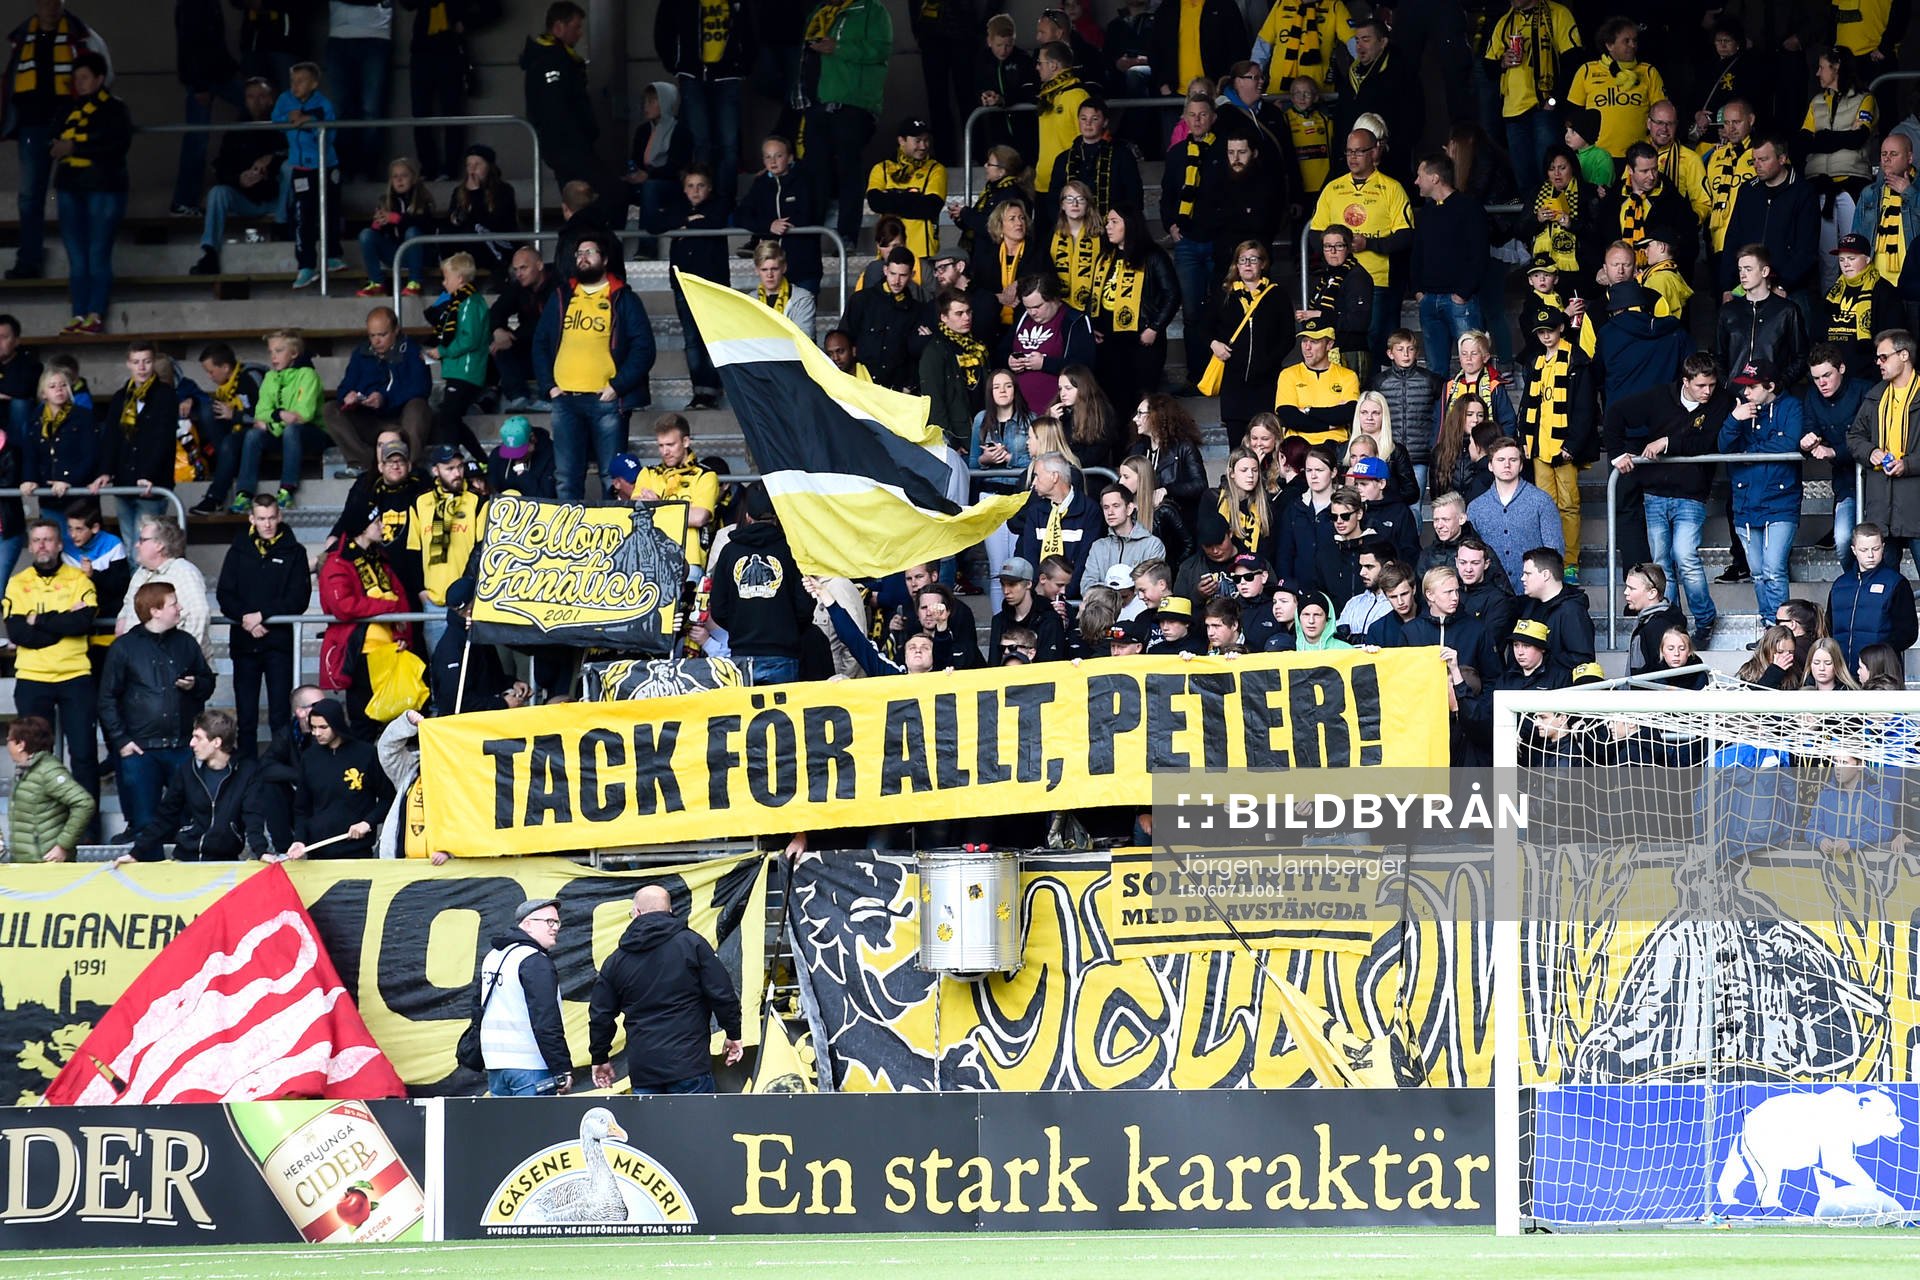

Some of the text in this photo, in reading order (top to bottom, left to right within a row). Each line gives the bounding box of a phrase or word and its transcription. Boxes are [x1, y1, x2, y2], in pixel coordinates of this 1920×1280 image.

[1594, 87, 1642, 107] ellos
[1712, 172, 1758, 191] eos
[562, 310, 606, 332] ellos
[488, 496, 624, 559] Yellow
[477, 542, 660, 610] Fanatics
[543, 609, 581, 622] 2001
[483, 663, 1383, 830] TACK FÖR ALLT, PETER!
[0, 911, 198, 950] ULIGANER
[1122, 897, 1368, 926] MED DE AVSTÄNGDA
[74, 959, 106, 976] 1991
[283, 1124, 355, 1181] HERRLJUNGA
[731, 1122, 1491, 1215] En stark karaktär
[295, 1140, 373, 1208] CIDER
[499, 1151, 681, 1217] GÄSENE MEJERI
[487, 1226, 528, 1235] SVERIGES
[530, 1226, 562, 1235] MINSTA
[565, 1224, 640, 1235] MEJERIFÖRENING
